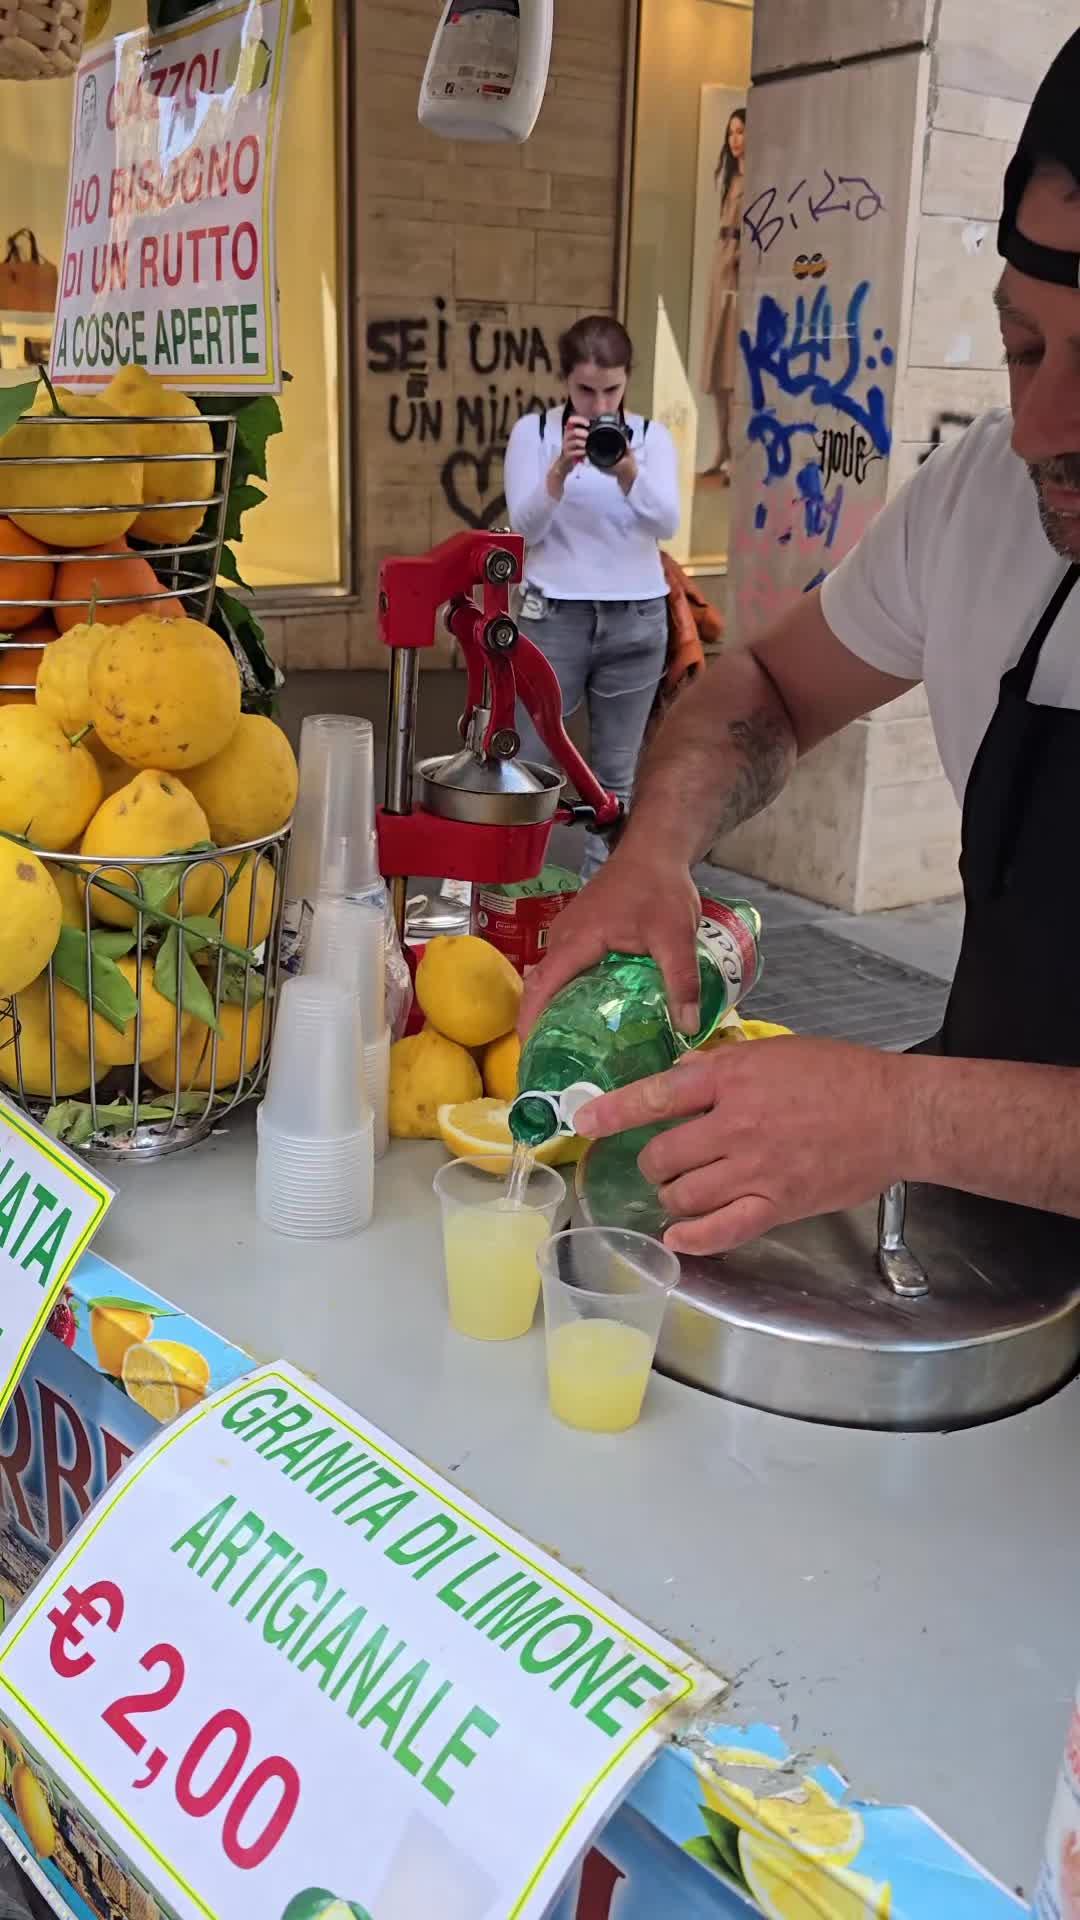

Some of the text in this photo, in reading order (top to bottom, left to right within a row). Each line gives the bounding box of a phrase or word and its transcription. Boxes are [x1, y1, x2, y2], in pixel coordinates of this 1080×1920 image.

[71, 174, 100, 230] HO
[64, 221, 258, 298] DI UN RUTTO
[56, 304, 259, 367] A COSCE APERTE
[469, 321, 552, 374] UNA
[388, 394, 441, 443] UN
[0, 1157, 73, 1288] ATA
[221, 1388, 670, 1738] GRANITA DI LIMONE
[170, 1495, 500, 1807] ARTIGIANALE
[47, 1580, 300, 1869] € 2,00
